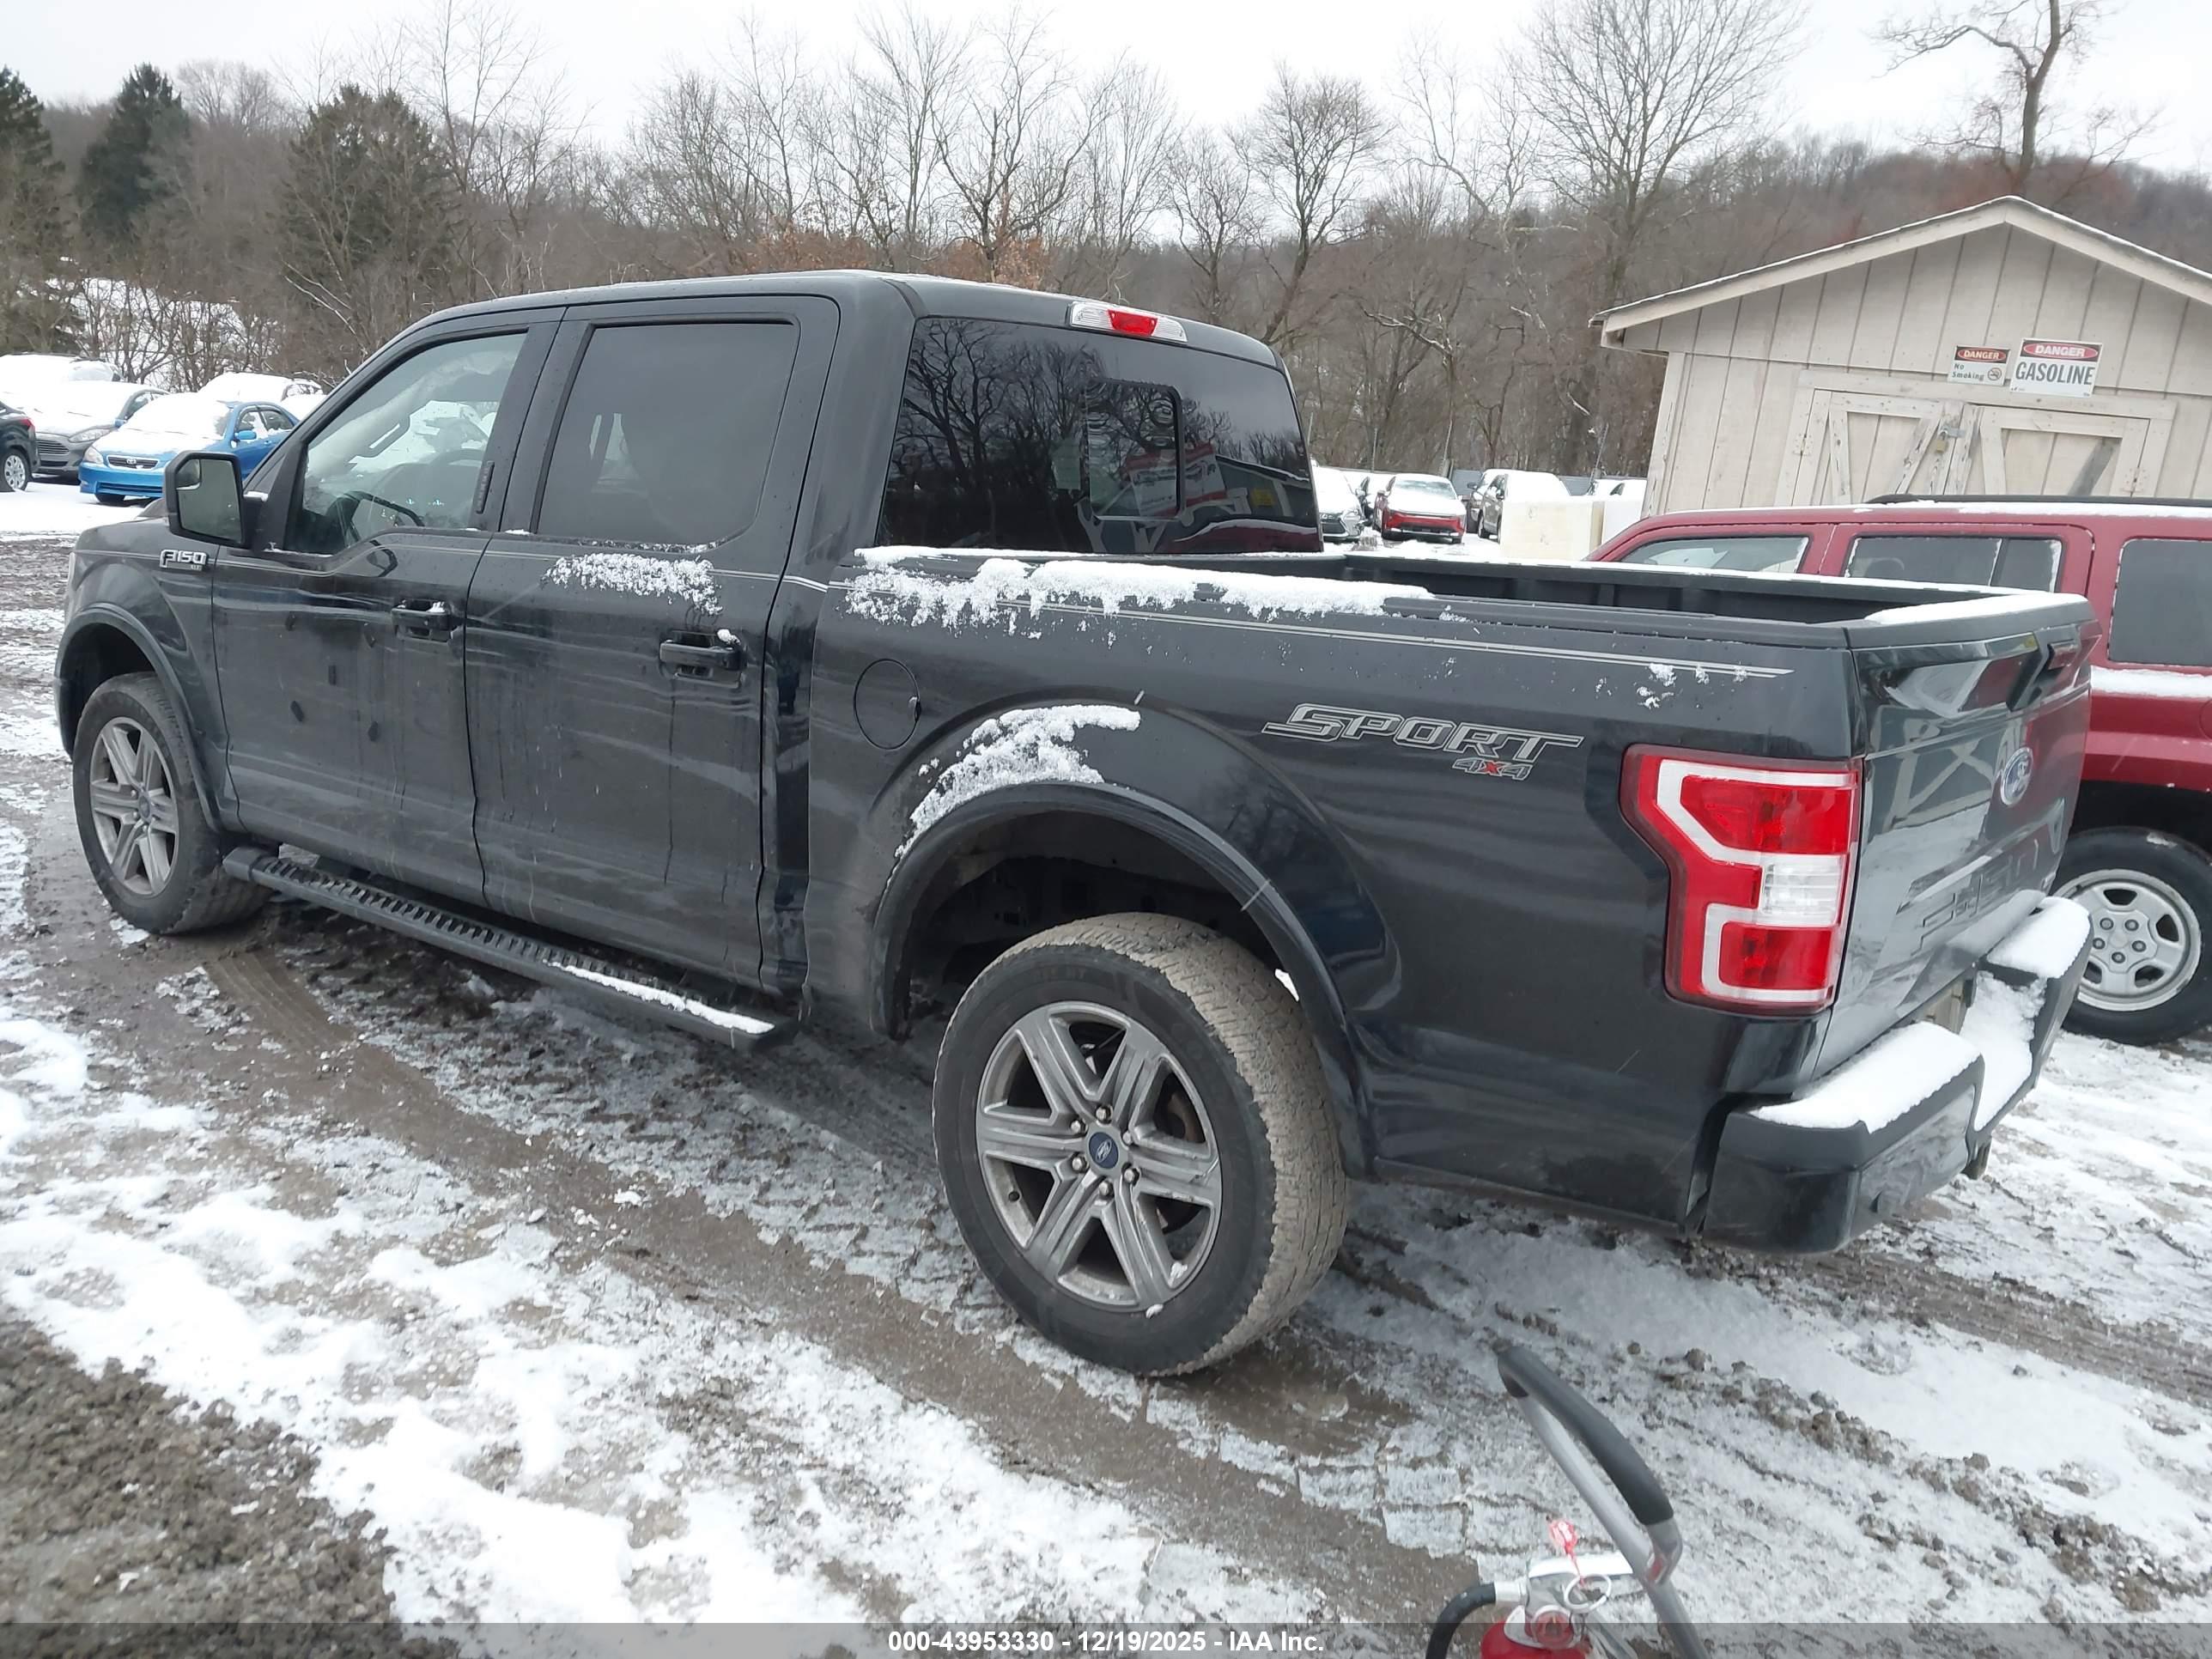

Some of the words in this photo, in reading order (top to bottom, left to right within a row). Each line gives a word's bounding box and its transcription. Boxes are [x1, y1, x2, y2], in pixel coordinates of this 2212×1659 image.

[1964, 350, 2000, 360] DANGER
[2034, 344, 2086, 357] DANGER
[1952, 371, 1984, 381] Smoking
[2015, 362, 2095, 385] GASOLINE
[1261, 702, 1585, 763] SPORT
